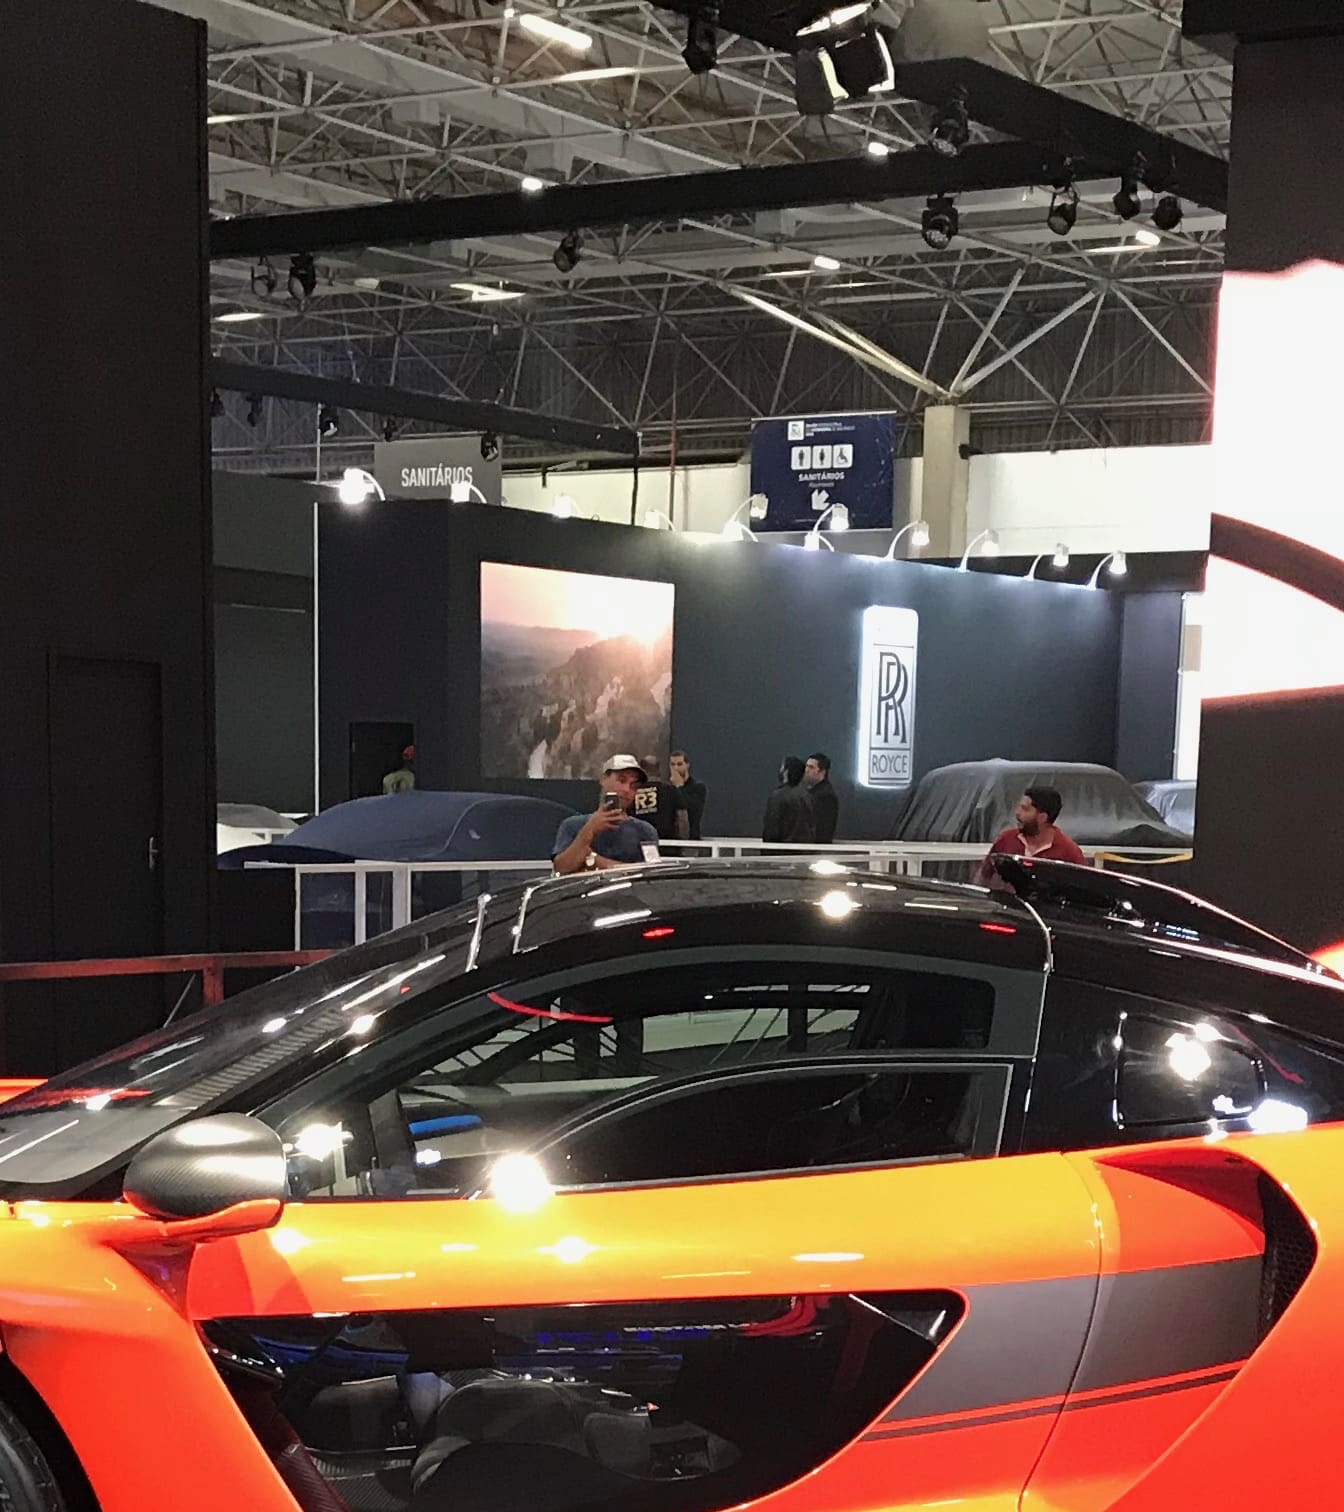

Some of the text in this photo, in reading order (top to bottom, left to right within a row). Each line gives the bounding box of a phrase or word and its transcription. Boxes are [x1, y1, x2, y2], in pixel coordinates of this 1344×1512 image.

[401, 463, 473, 487] SANITÁRIOS
[871, 754, 908, 774] ROYCE
[635, 791, 657, 810] R3
